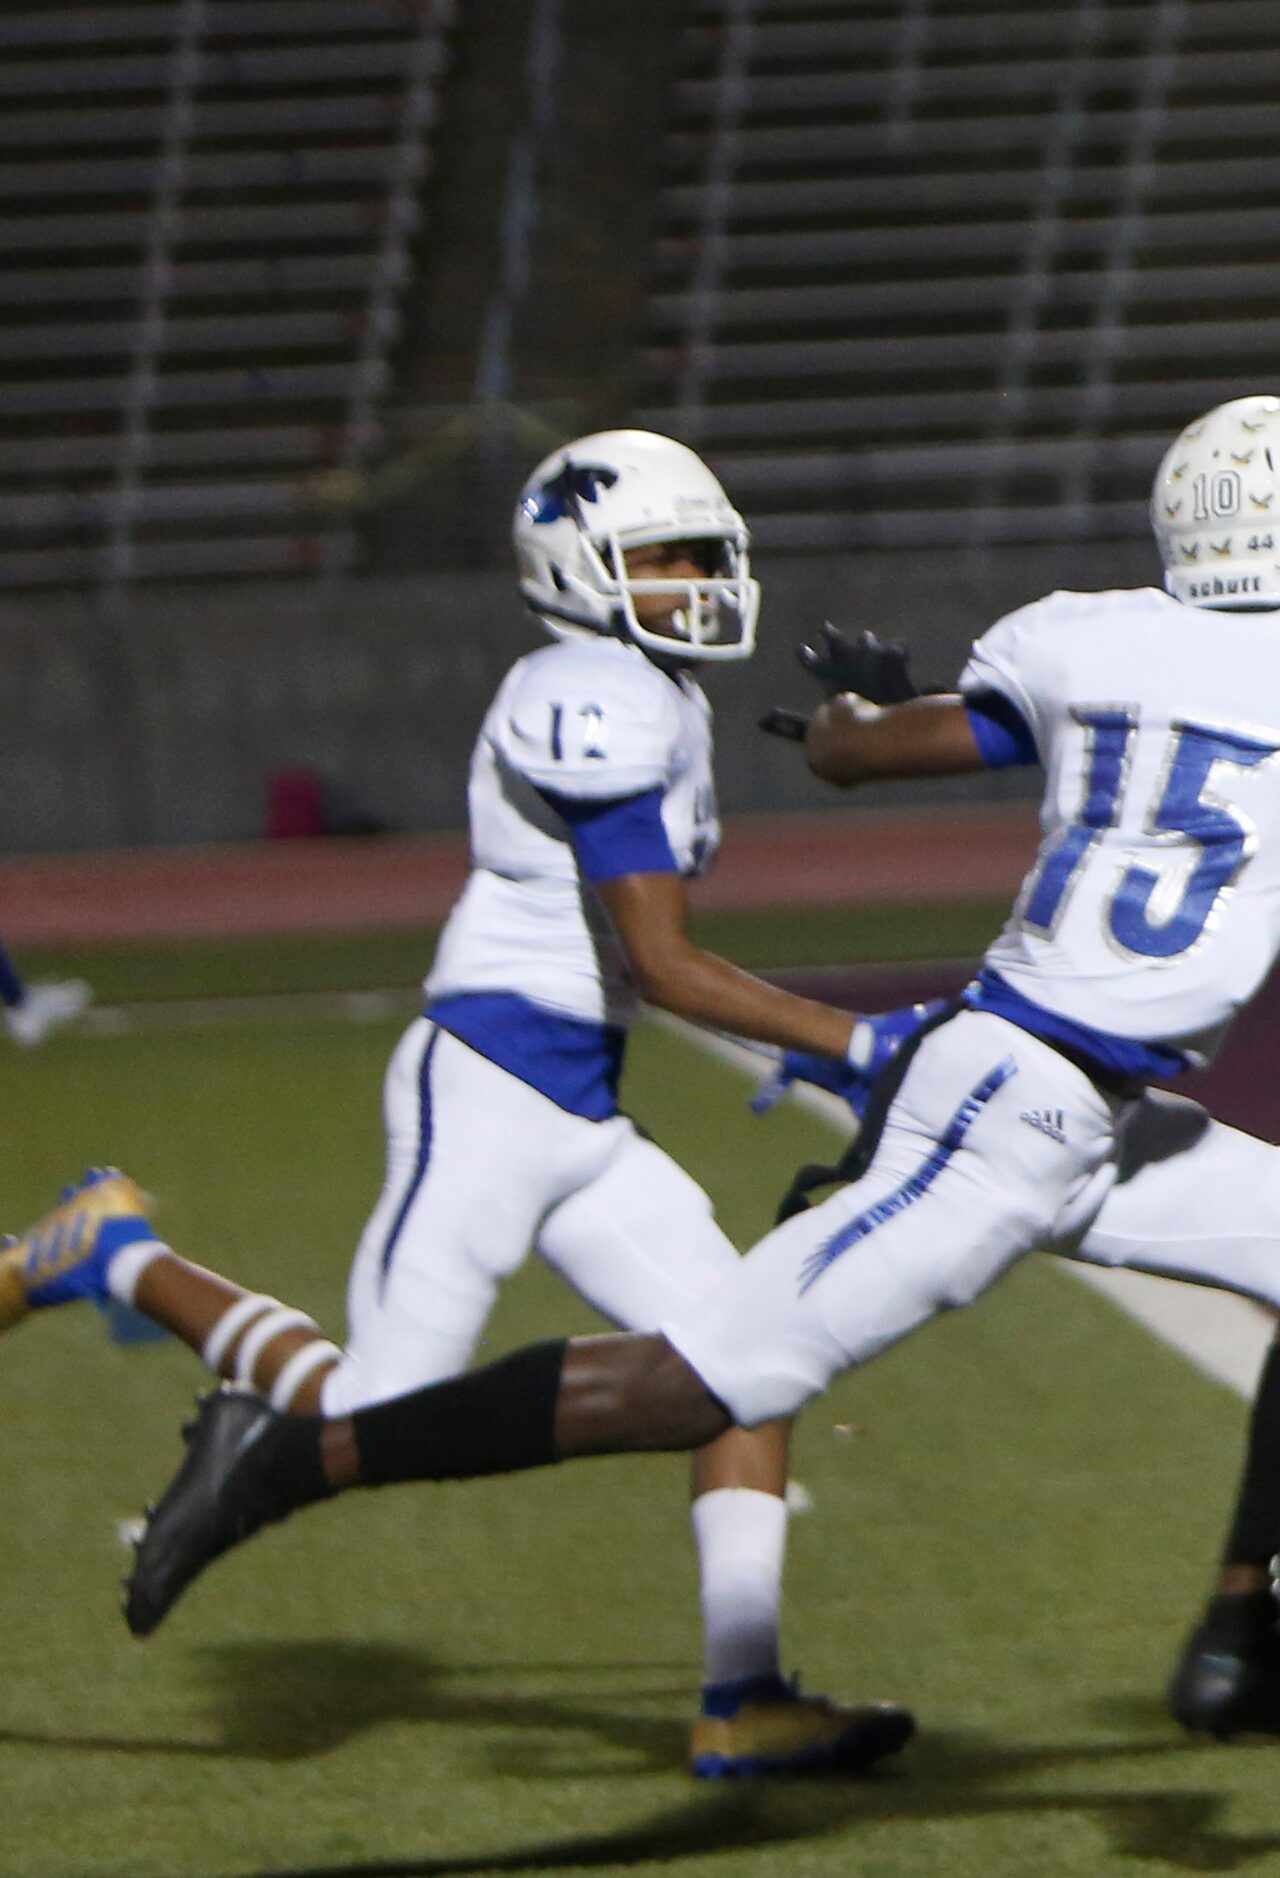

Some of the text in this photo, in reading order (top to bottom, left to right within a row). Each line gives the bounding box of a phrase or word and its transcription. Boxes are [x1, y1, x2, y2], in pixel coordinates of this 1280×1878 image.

[1193, 469, 1241, 520] 10
[1247, 533, 1274, 551] 44
[1188, 575, 1261, 598] schutt
[550, 701, 606, 761] 12
